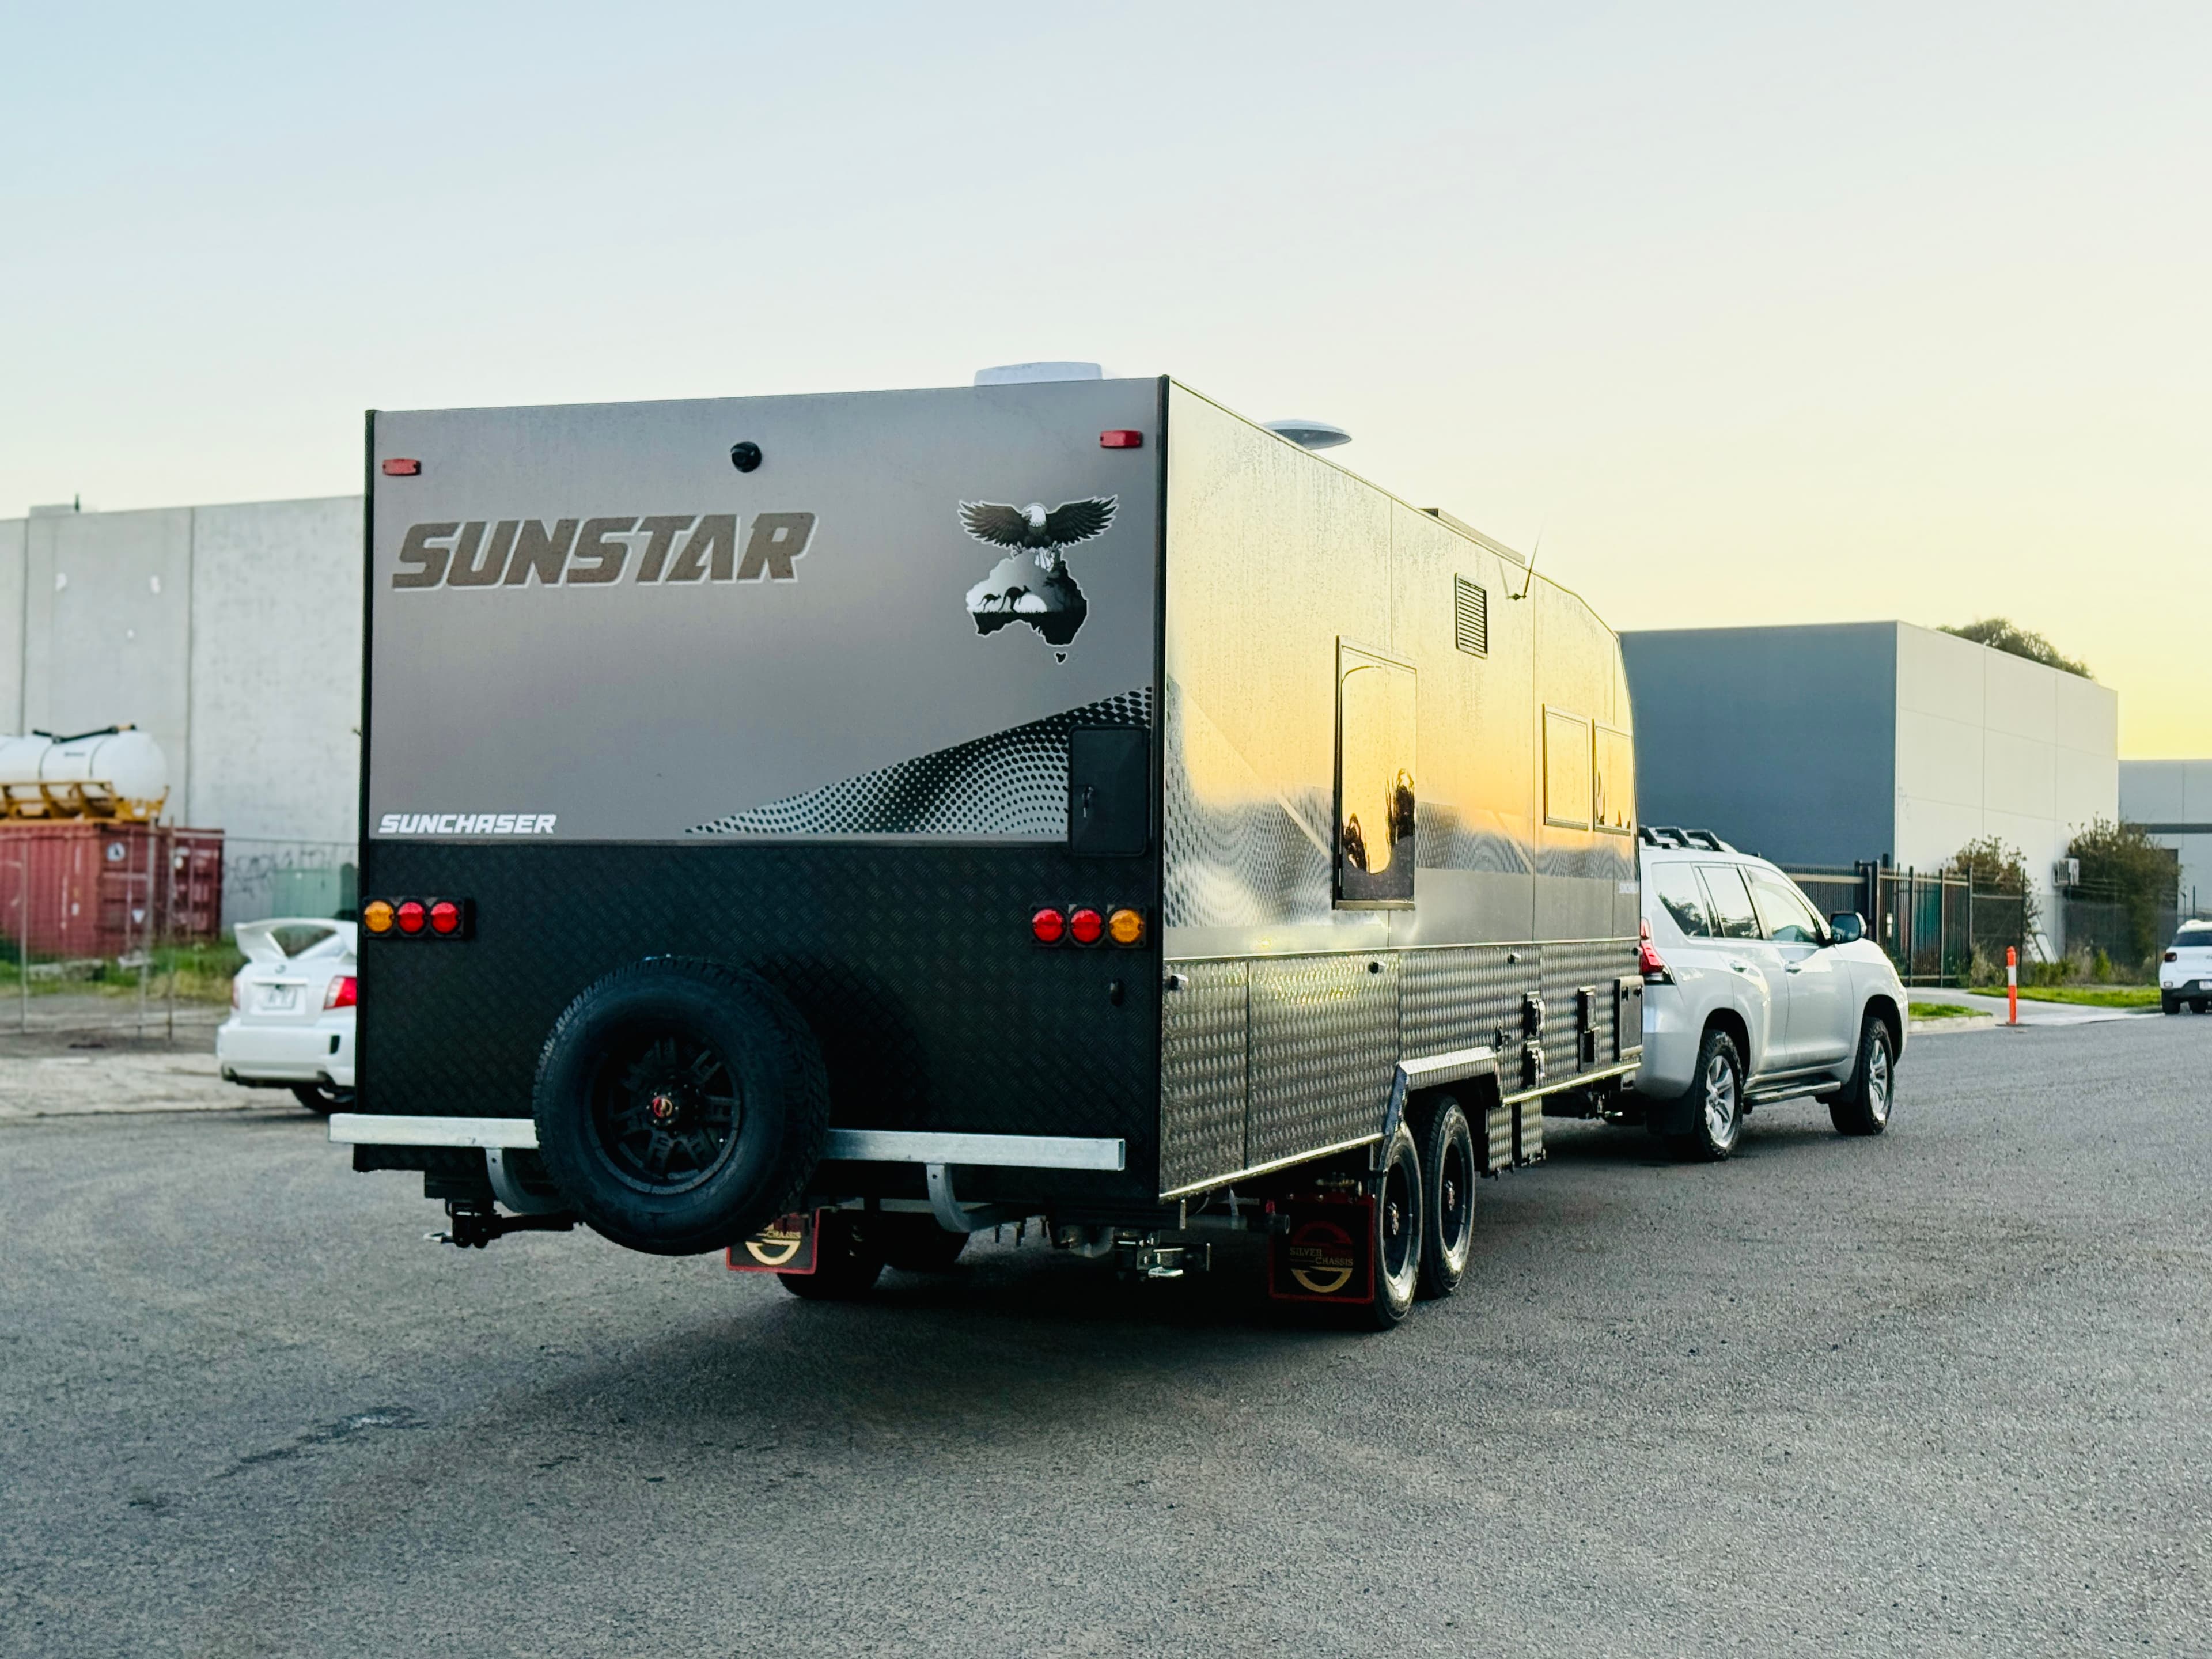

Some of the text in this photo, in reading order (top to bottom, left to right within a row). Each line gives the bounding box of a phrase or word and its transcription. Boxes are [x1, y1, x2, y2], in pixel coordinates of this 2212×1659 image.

[392, 512, 819, 592] SUNSTAR
[378, 813, 557, 834] SUNCHASER
[1290, 1247, 1322, 1257] SILVER
[1315, 1257, 1354, 1266] CHASSIS
